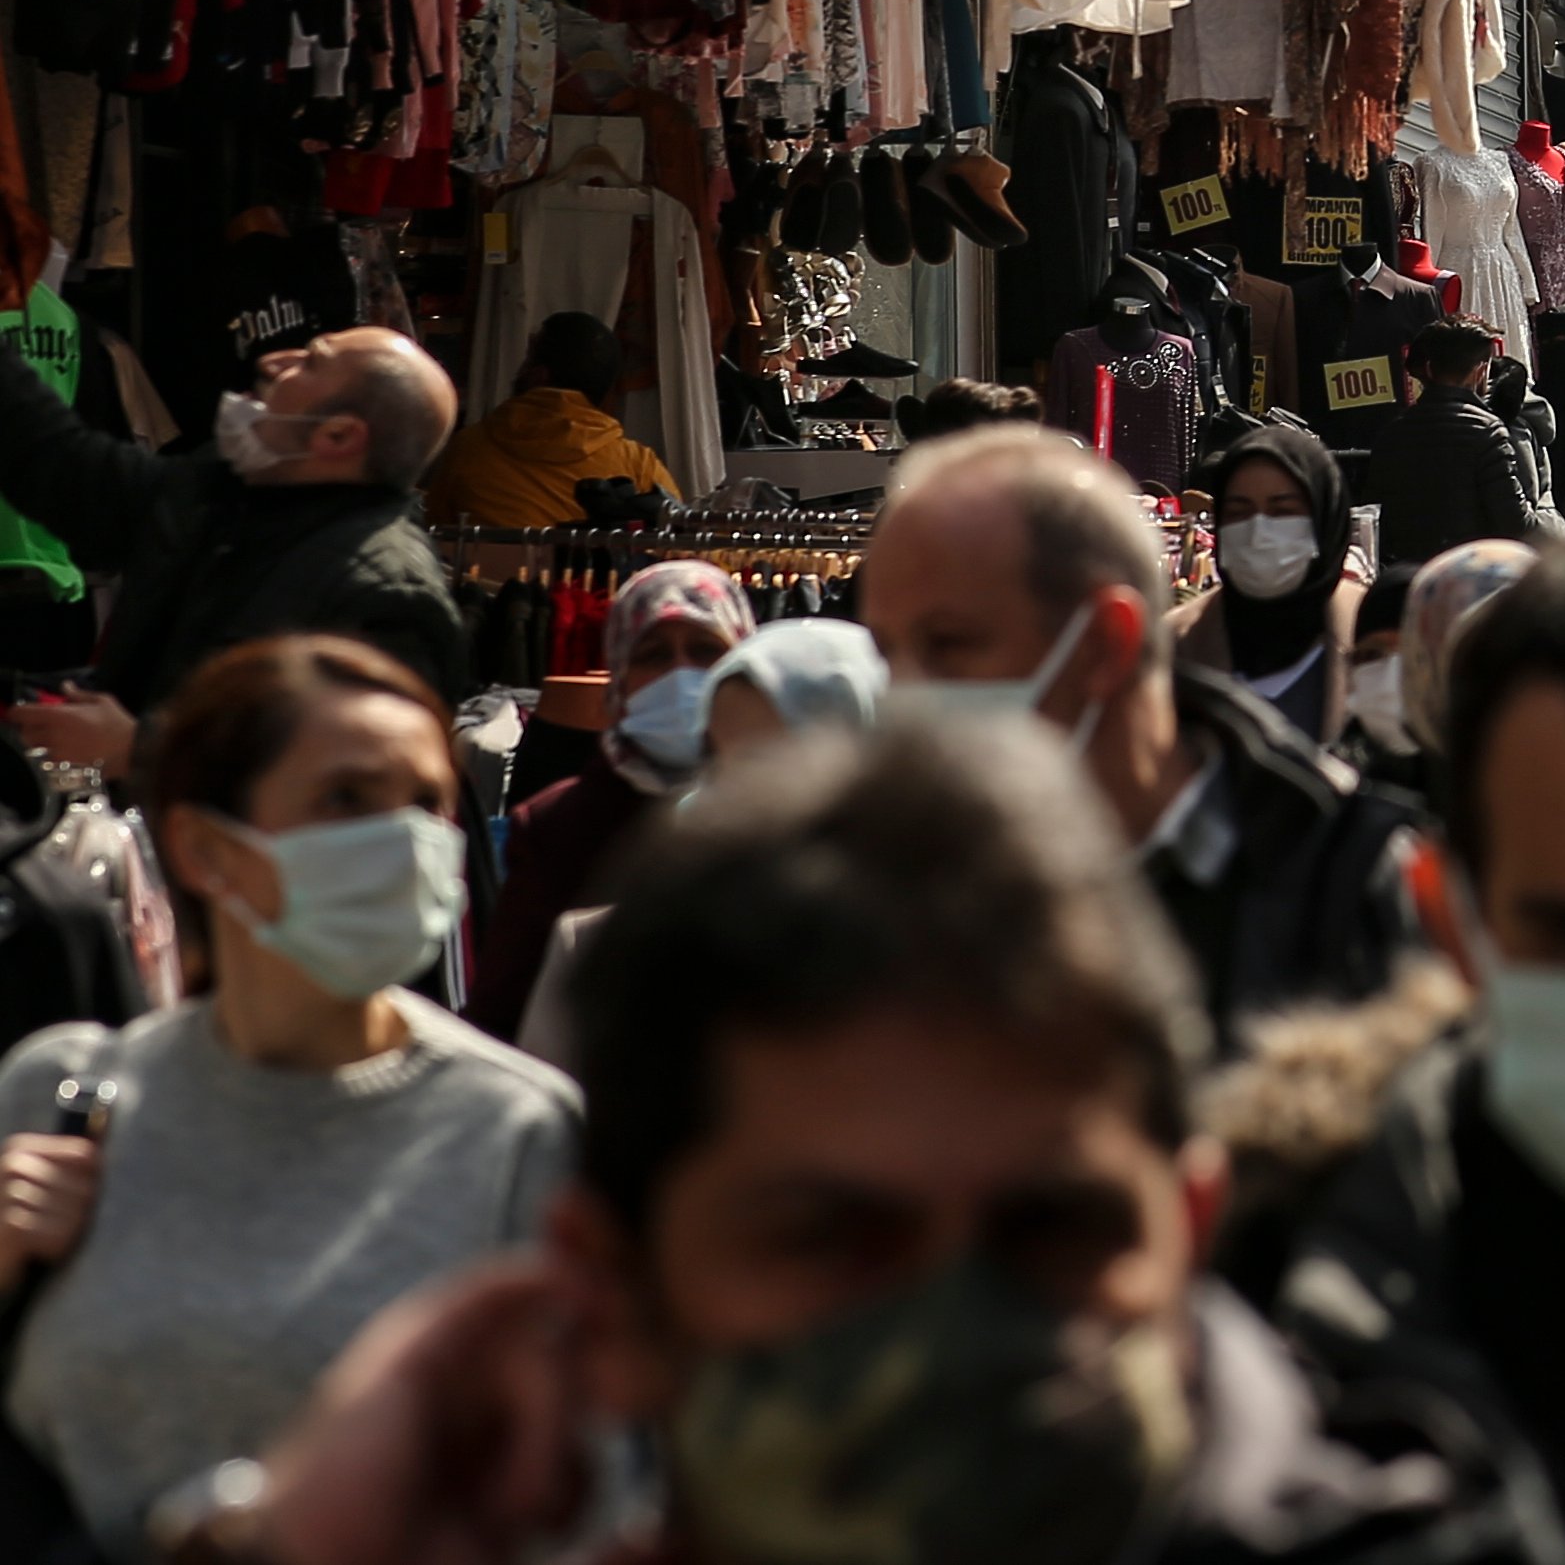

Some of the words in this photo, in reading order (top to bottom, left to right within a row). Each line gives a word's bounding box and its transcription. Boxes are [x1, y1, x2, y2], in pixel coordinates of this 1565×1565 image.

[1168, 188, 1213, 225] 100
[1305, 217, 1347, 250] 100
[1331, 368, 1378, 401] 100
